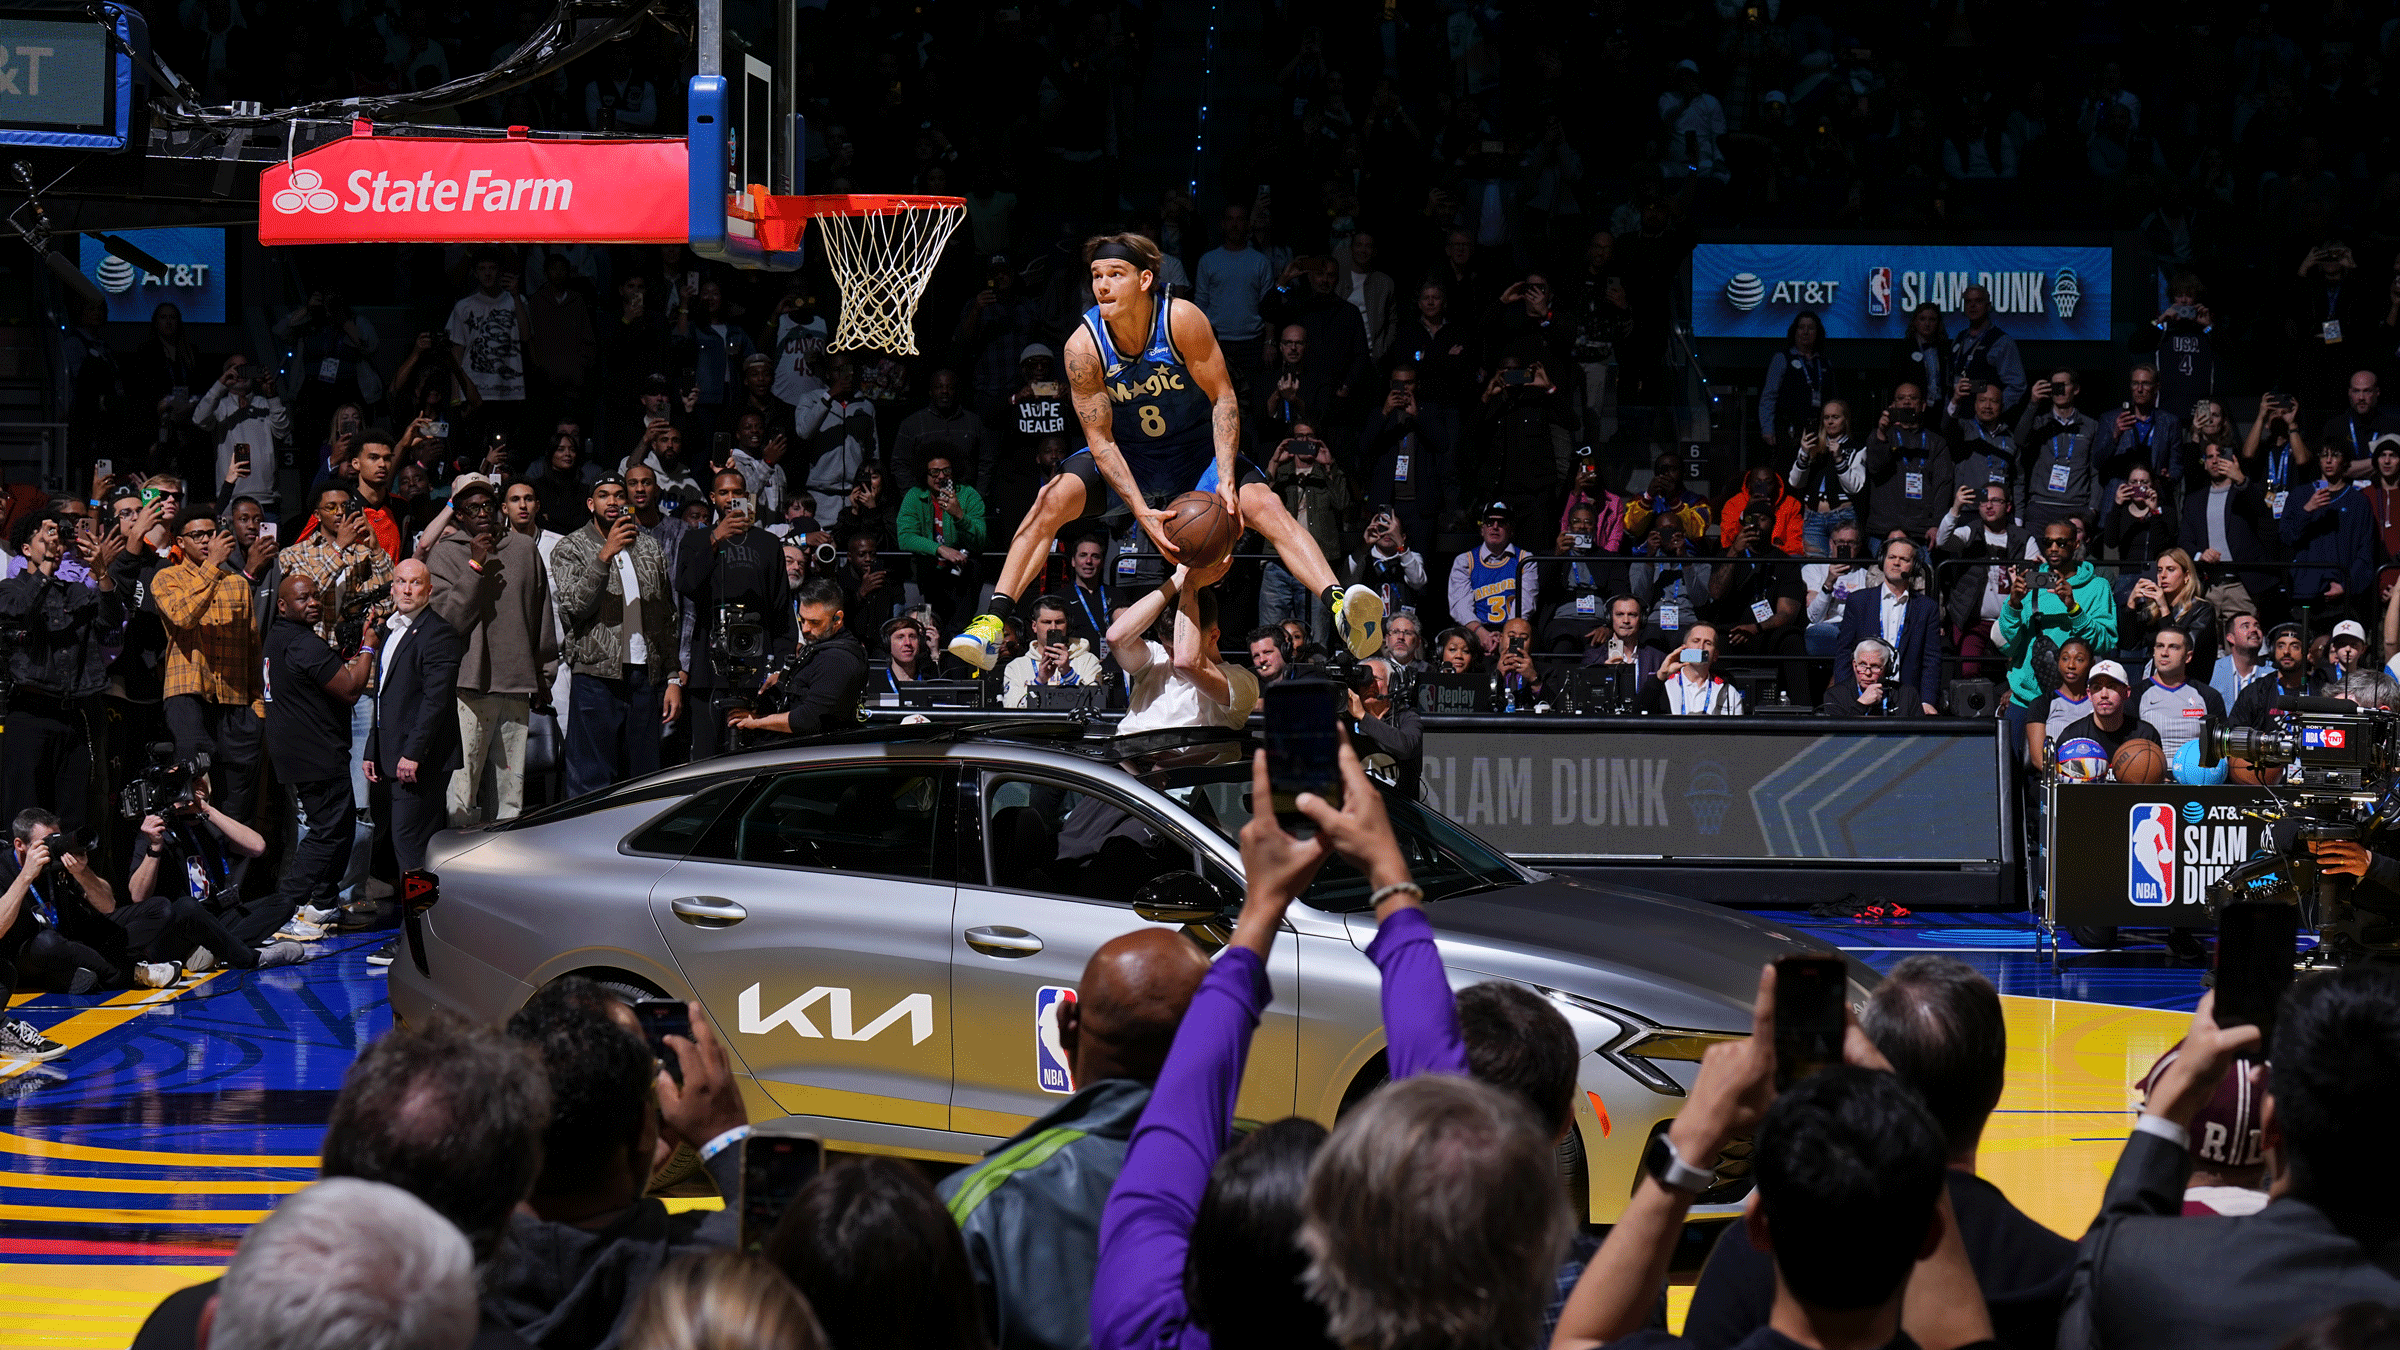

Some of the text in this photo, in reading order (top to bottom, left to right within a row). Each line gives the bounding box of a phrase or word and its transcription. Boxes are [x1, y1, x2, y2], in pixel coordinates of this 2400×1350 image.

[1771, 280, 1839, 304] AT&T
[1901, 271, 1968, 312] SLAM
[2173, 336, 2200, 353] USA
[2178, 354, 2193, 377] 4
[1019, 401, 1061, 419] HOPE
[1019, 417, 1065, 434] DEALER
[1138, 405, 1166, 438] 8
[1690, 444, 1700, 458] 6
[1690, 463, 1700, 478] 5
[1474, 578, 1516, 601] ARRIOR
[1438, 685, 1476, 707] Replay
[1422, 756, 1669, 827] SLAM DUNK
[2207, 806, 2245, 821] AT&
[2183, 825, 2248, 866] SLAM
[2136, 883, 2158, 900] NBA
[2183, 866, 2231, 906] DU
[738, 981, 934, 1047] KIA
[1044, 1068, 1064, 1087] NBA
